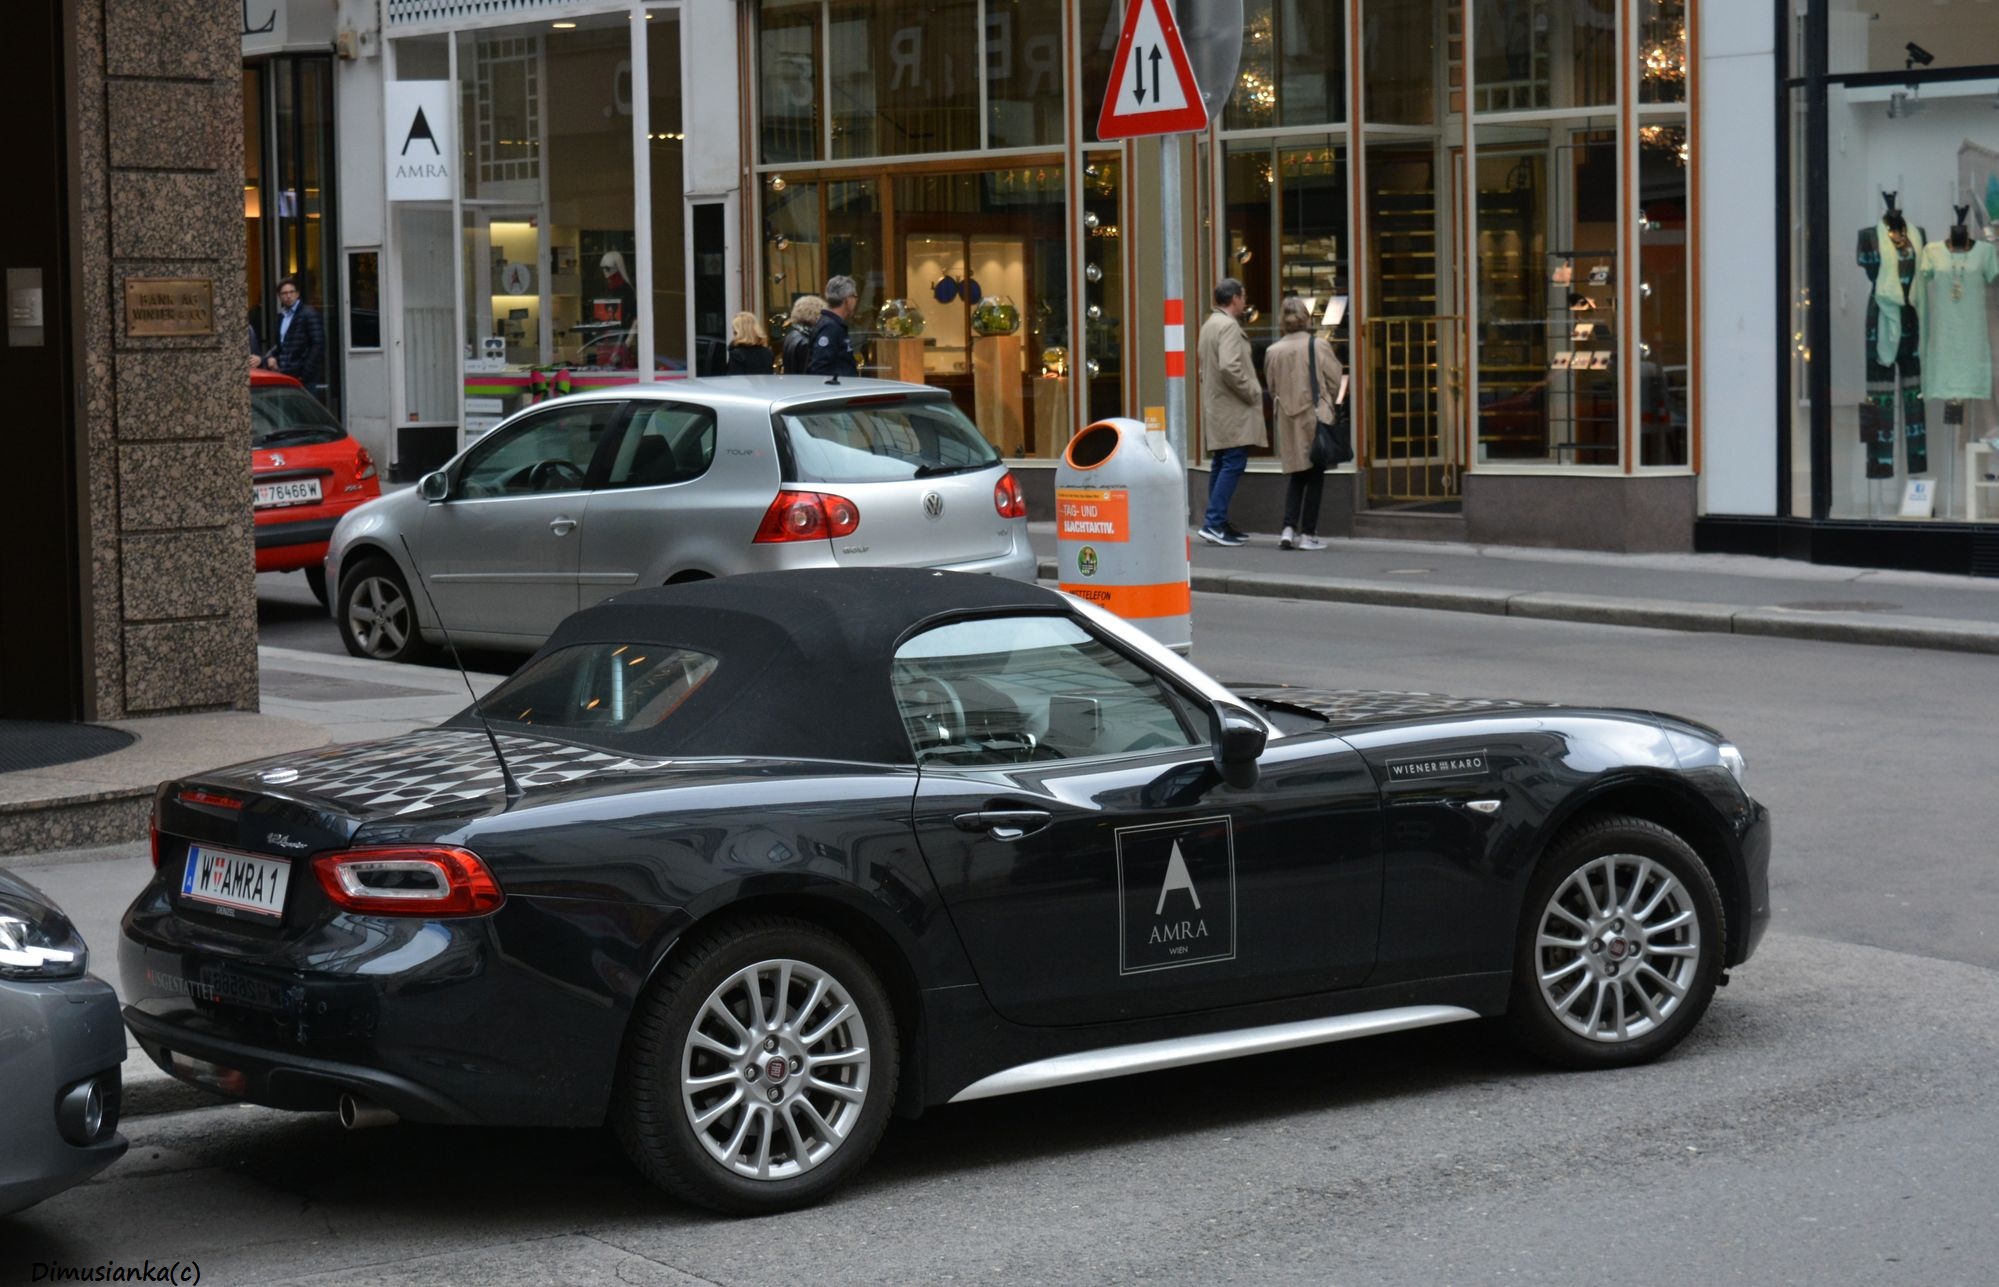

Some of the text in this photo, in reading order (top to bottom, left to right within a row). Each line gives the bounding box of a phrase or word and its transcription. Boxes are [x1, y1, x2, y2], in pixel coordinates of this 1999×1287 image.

[395, 164, 448, 178] AMRA
[1081, 505, 1098, 517] UND
[1393, 758, 1481, 775] WIENER KARO
[200, 855, 214, 891] W
[1148, 919, 1209, 944] AMRA
[1169, 946, 1189, 955] WIEN
